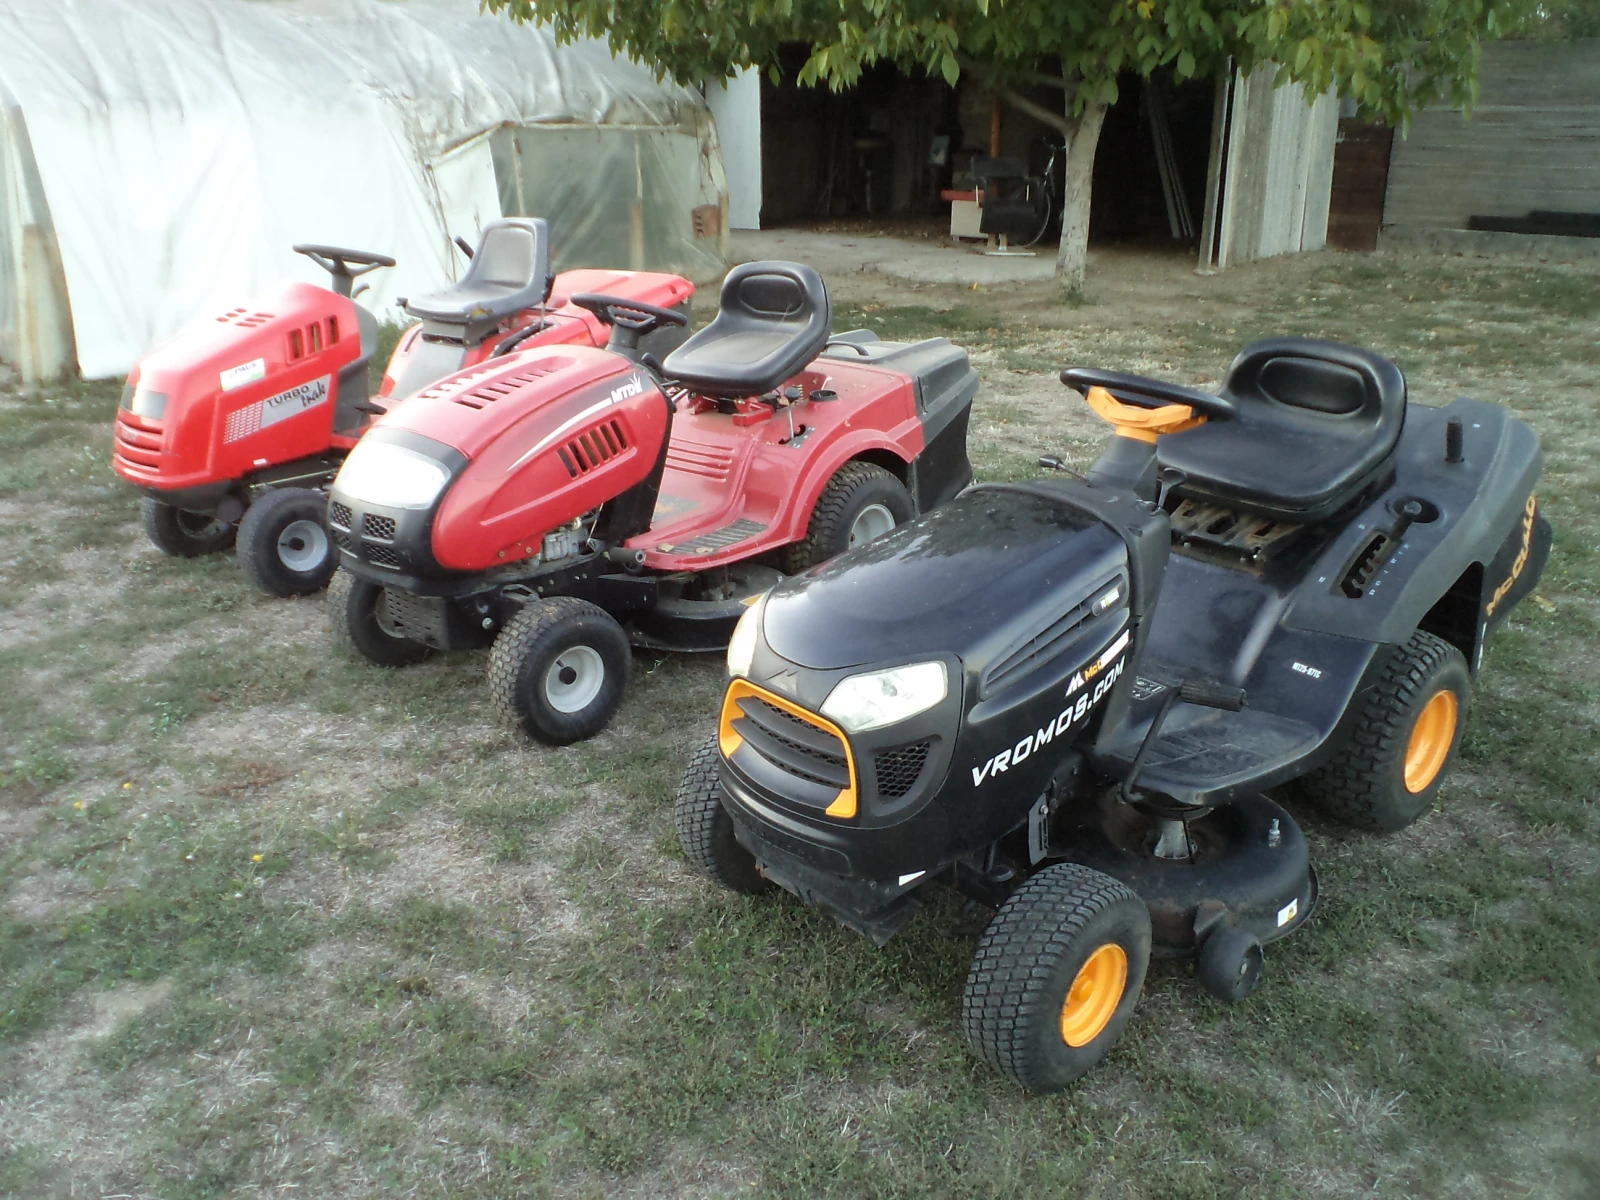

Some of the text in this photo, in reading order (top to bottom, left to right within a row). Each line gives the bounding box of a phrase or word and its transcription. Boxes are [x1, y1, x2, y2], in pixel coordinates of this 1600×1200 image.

[266, 385, 309, 408] TURBO
[611, 384, 636, 403] MTD
[971, 654, 1126, 787] VROMOS.COM
